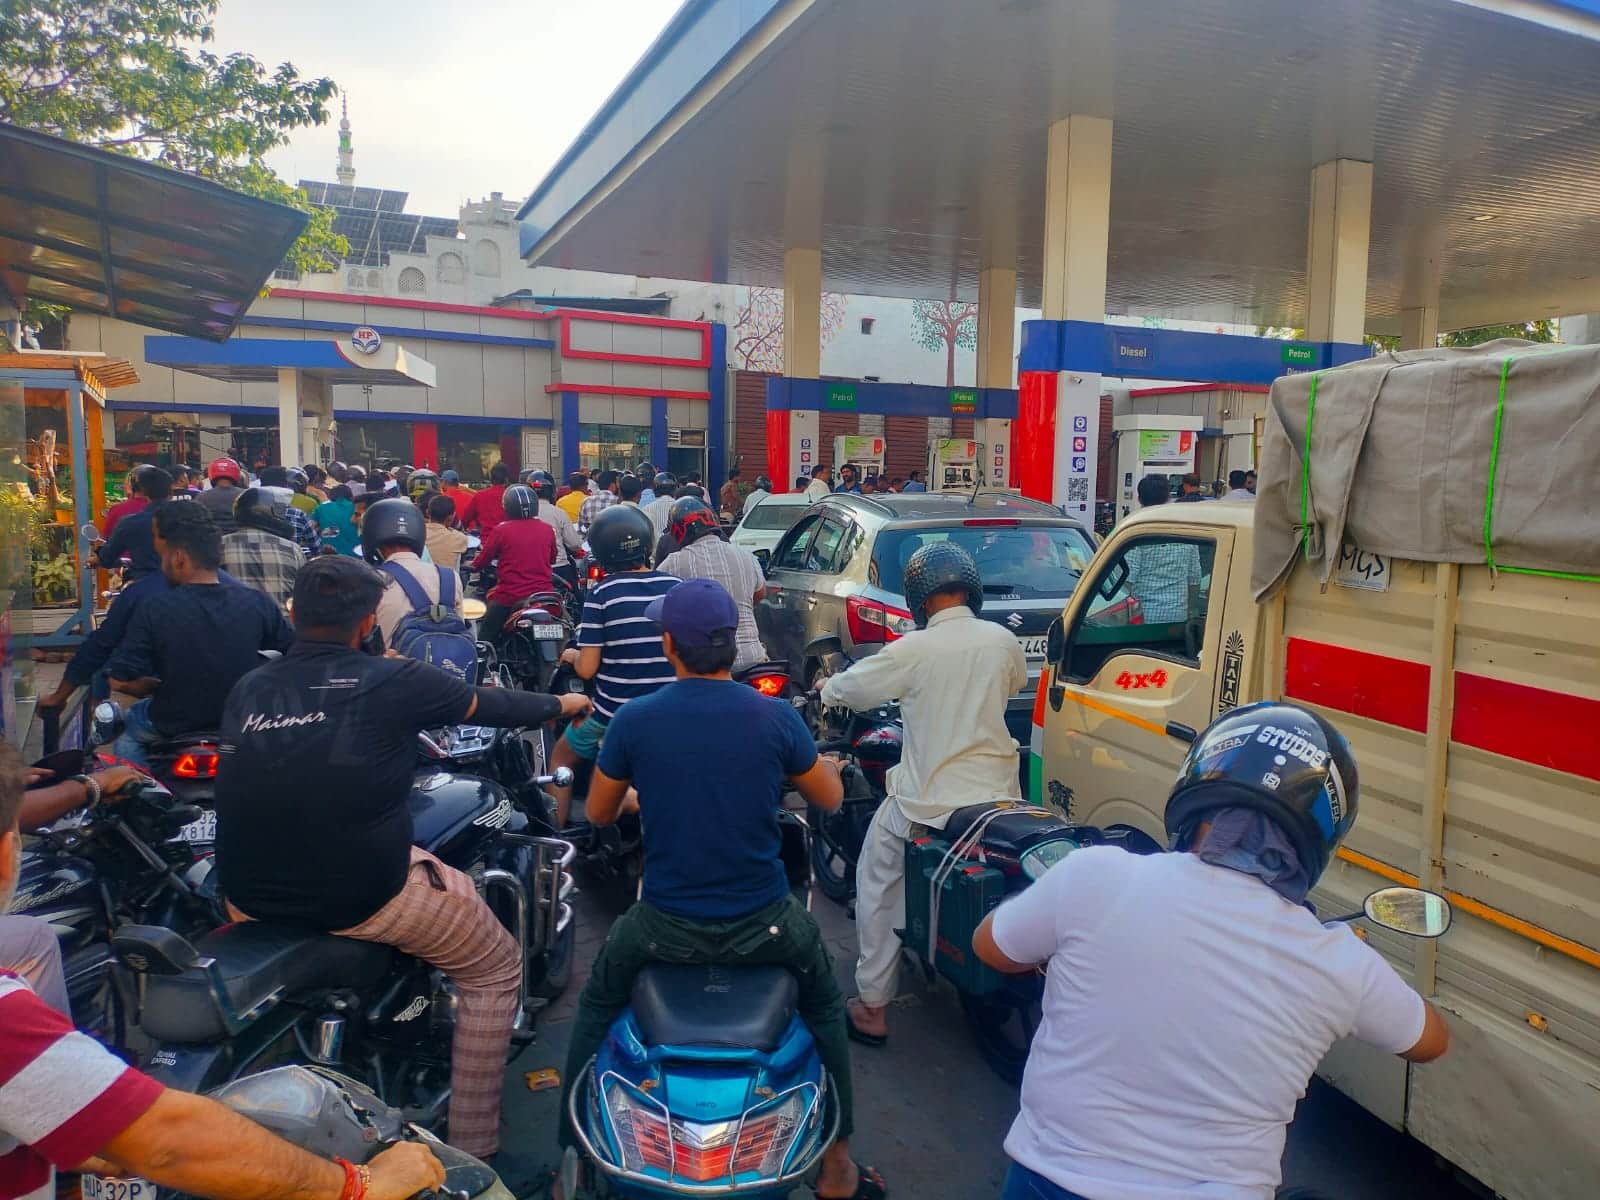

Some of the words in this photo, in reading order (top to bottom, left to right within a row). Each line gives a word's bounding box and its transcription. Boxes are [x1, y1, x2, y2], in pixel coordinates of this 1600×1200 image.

[1119, 345, 1147, 358] Diesel
[1288, 348, 1311, 359] Petrol
[831, 392, 854, 402] Petrol
[953, 393, 974, 401] Petrol
[1114, 667, 1169, 691] 4x4
[1222, 655, 1240, 702] TATA
[1256, 725, 1327, 769] STUDDS
